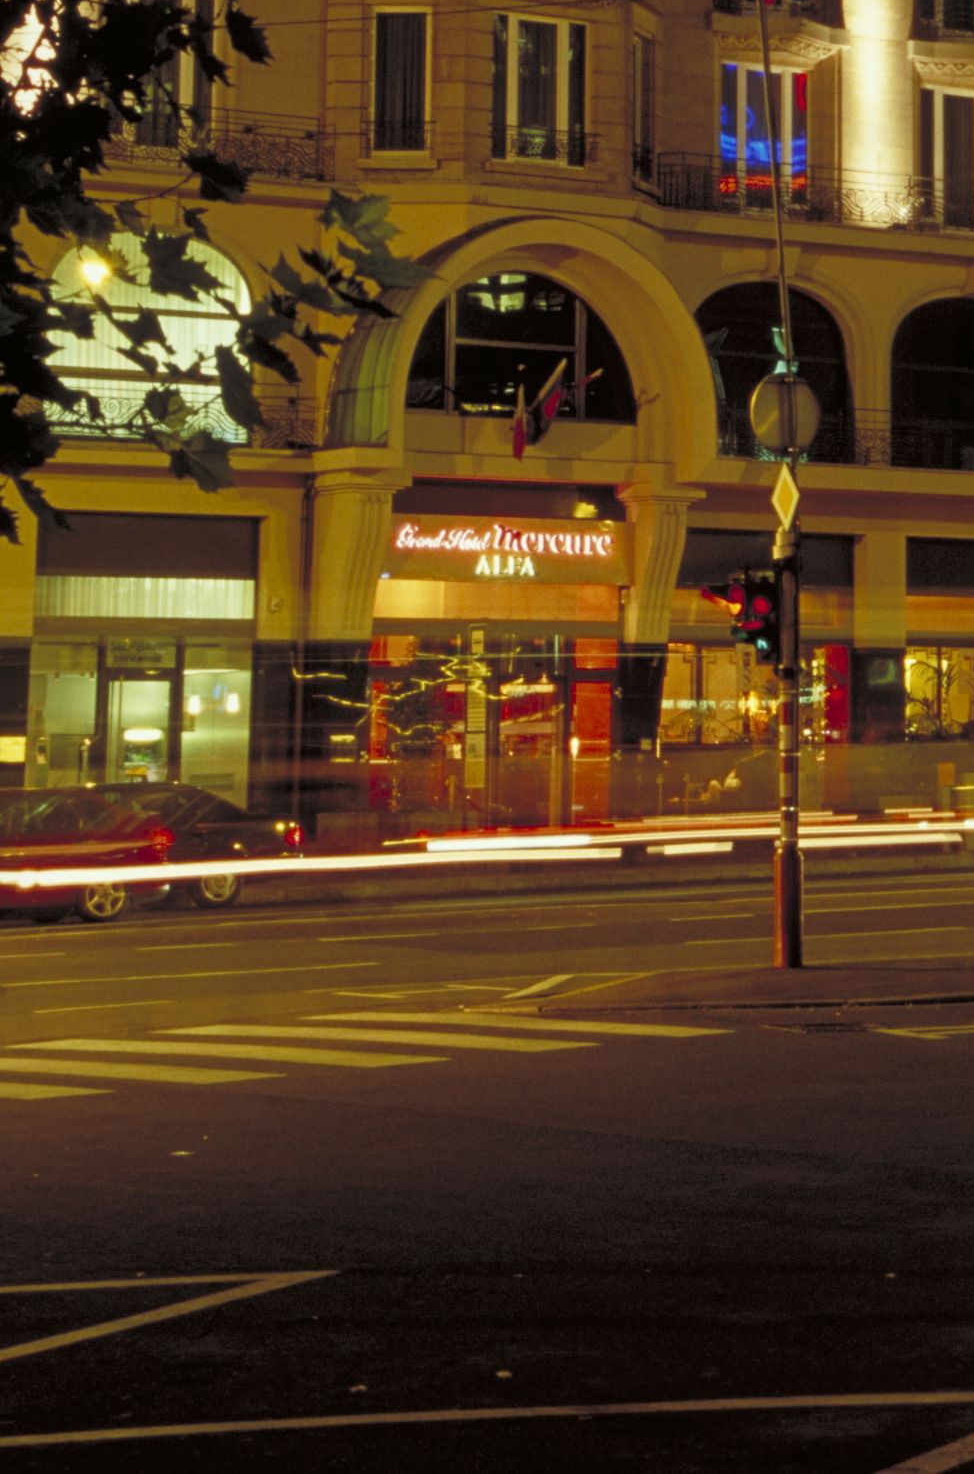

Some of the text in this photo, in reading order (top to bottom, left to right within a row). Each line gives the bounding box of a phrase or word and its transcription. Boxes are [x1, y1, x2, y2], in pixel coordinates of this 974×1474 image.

[396, 523, 446, 549] Grand
[493, 524, 613, 556] Mercure
[475, 554, 536, 577] ALFA
